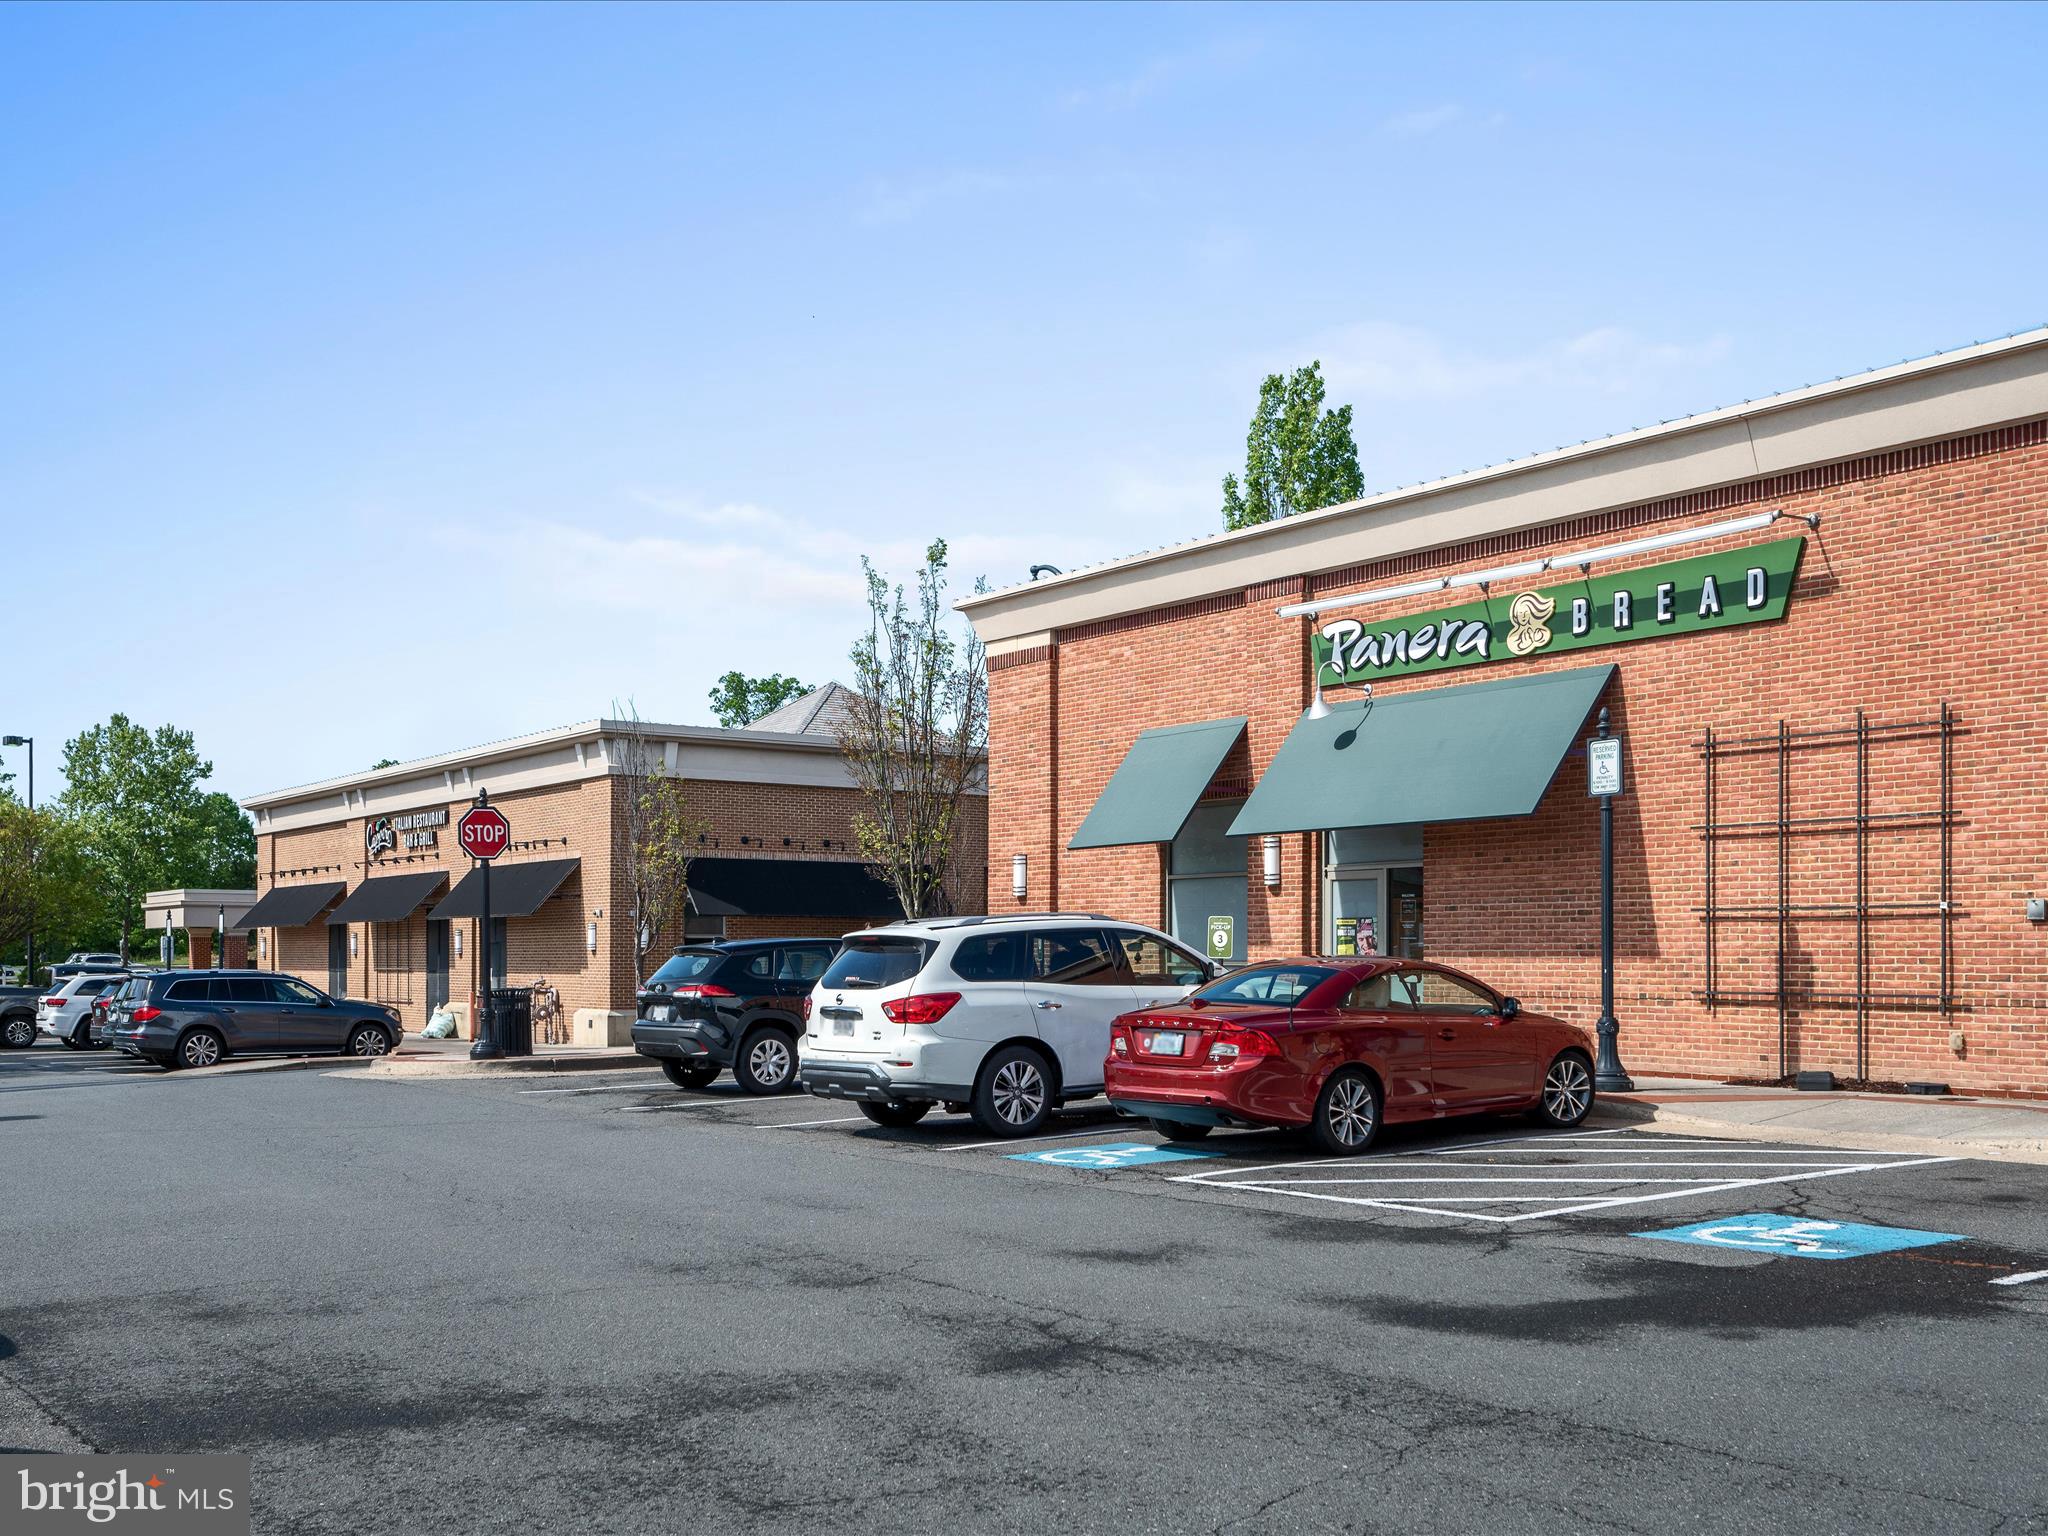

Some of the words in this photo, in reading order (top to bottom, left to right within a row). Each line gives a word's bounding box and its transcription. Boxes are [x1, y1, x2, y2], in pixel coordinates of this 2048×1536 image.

[1322, 619, 1490, 675] Panera
[1571, 566, 1768, 637] BREAD
[1593, 744, 1616, 753] RESERVED
[394, 815, 413, 830] ITALIAN
[413, 810, 446, 828] RESTAURANT
[403, 833, 414, 848] BAR
[419, 831, 434, 846] GRILL
[464, 824, 505, 843] STOP
[1217, 934, 1223, 944] 3
